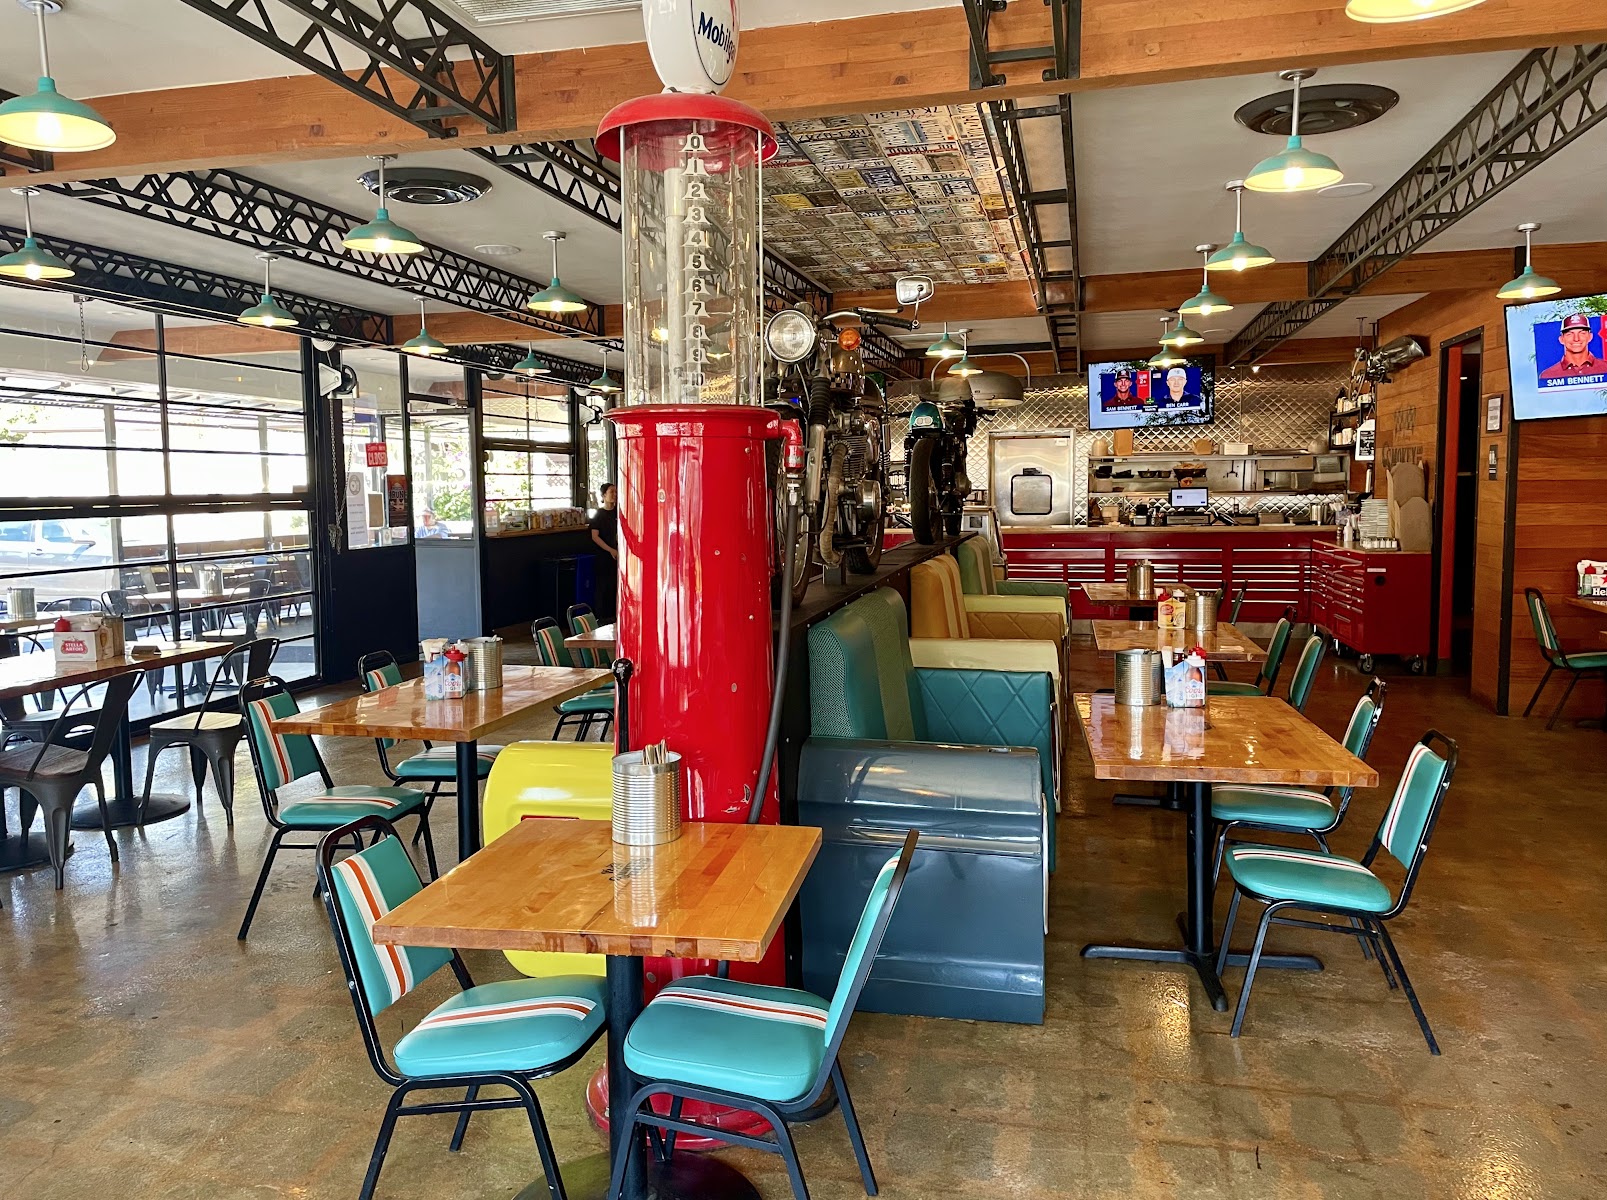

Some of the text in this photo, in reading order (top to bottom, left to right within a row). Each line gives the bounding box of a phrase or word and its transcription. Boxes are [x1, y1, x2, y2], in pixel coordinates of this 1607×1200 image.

[690, 136, 700, 149] 0
[691, 184, 700, 197] 2
[691, 208, 701, 222] 3
[691, 232, 701, 246] 4
[692, 256, 702, 269] 5
[692, 279, 702, 292] 6
[692, 302, 702, 315] 7
[692, 325, 703, 339] 8
[692, 349, 702, 361] 9
[691, 373, 704, 386] 10
[1547, 375, 1605, 387] SAM BENNETT
[368, 452, 387, 466] CLOSED
